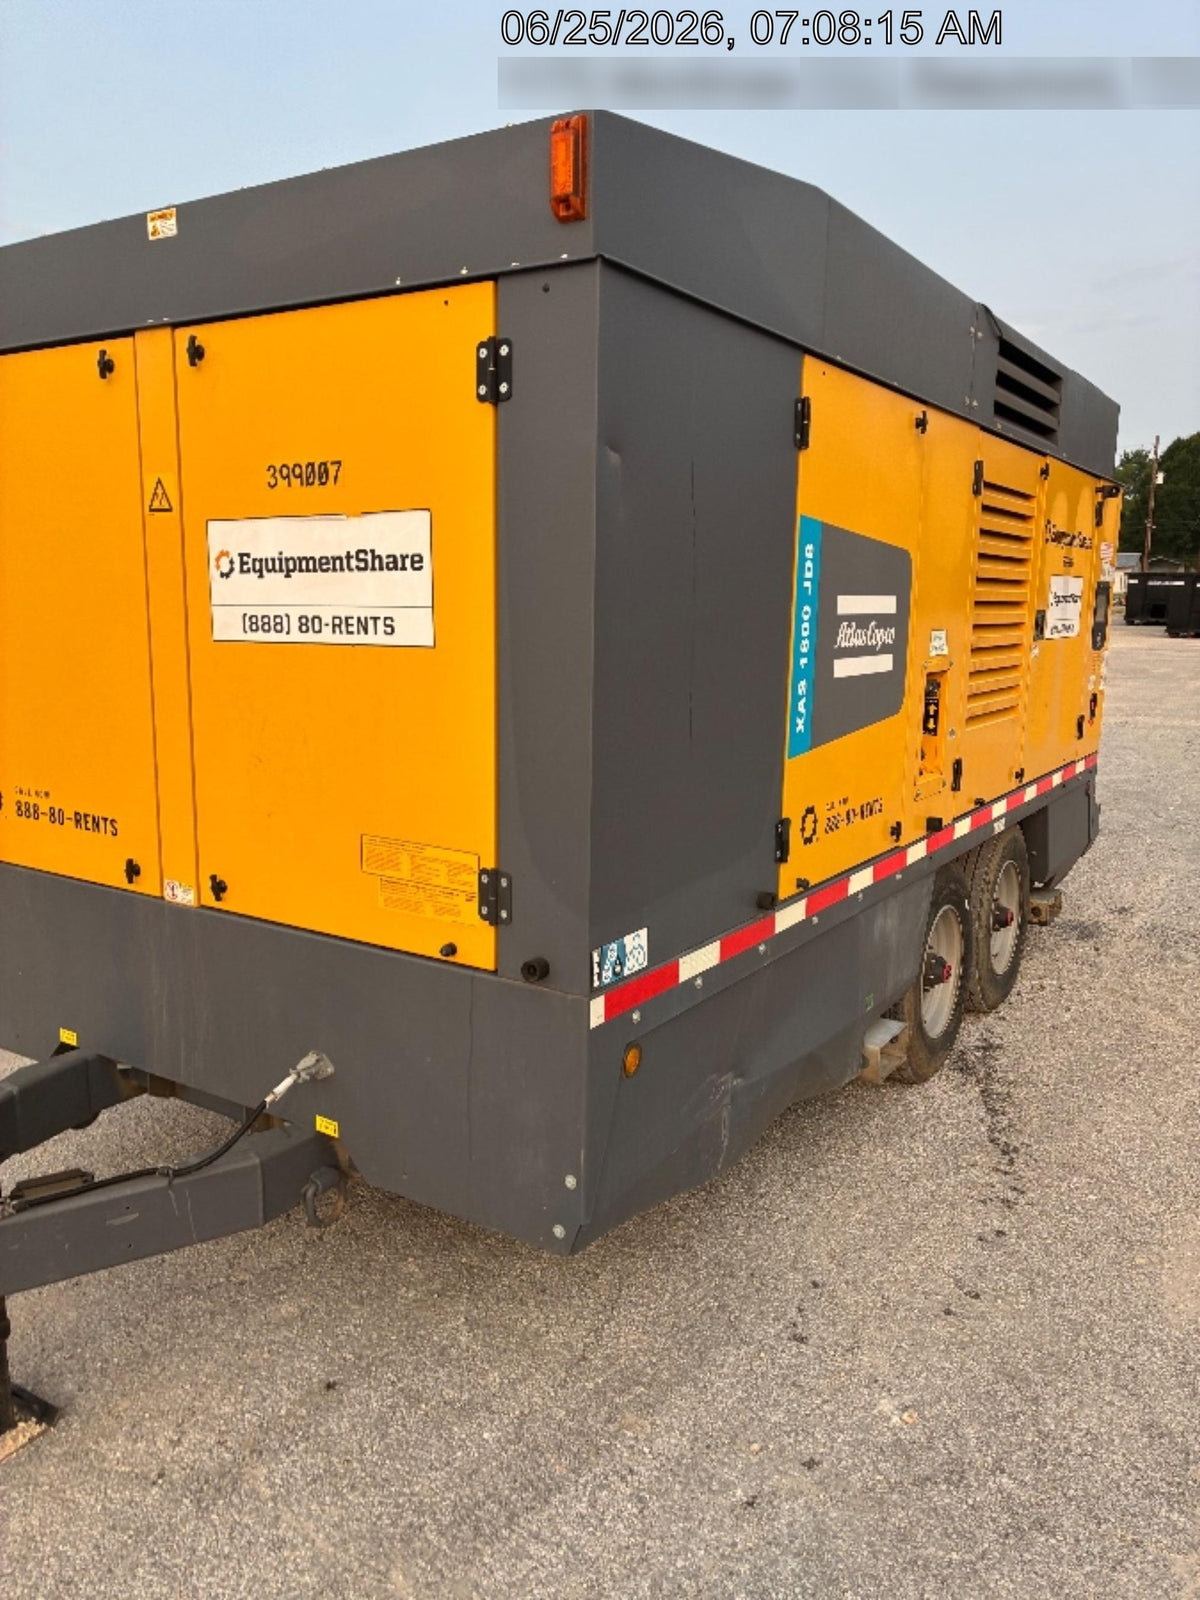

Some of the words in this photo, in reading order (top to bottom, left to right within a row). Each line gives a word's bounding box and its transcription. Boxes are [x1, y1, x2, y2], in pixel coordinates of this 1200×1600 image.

[266, 460, 342, 489] 399007
[238, 549, 424, 578] EquipmentShare
[242, 613, 291, 635] (888)
[298, 615, 396, 636] 80-RENTS
[800, 604, 812, 669] 1800
[834, 621, 867, 648] Atlas
[796, 678, 807, 733] XAS
[15, 799, 118, 837] 888-80-RENTS
